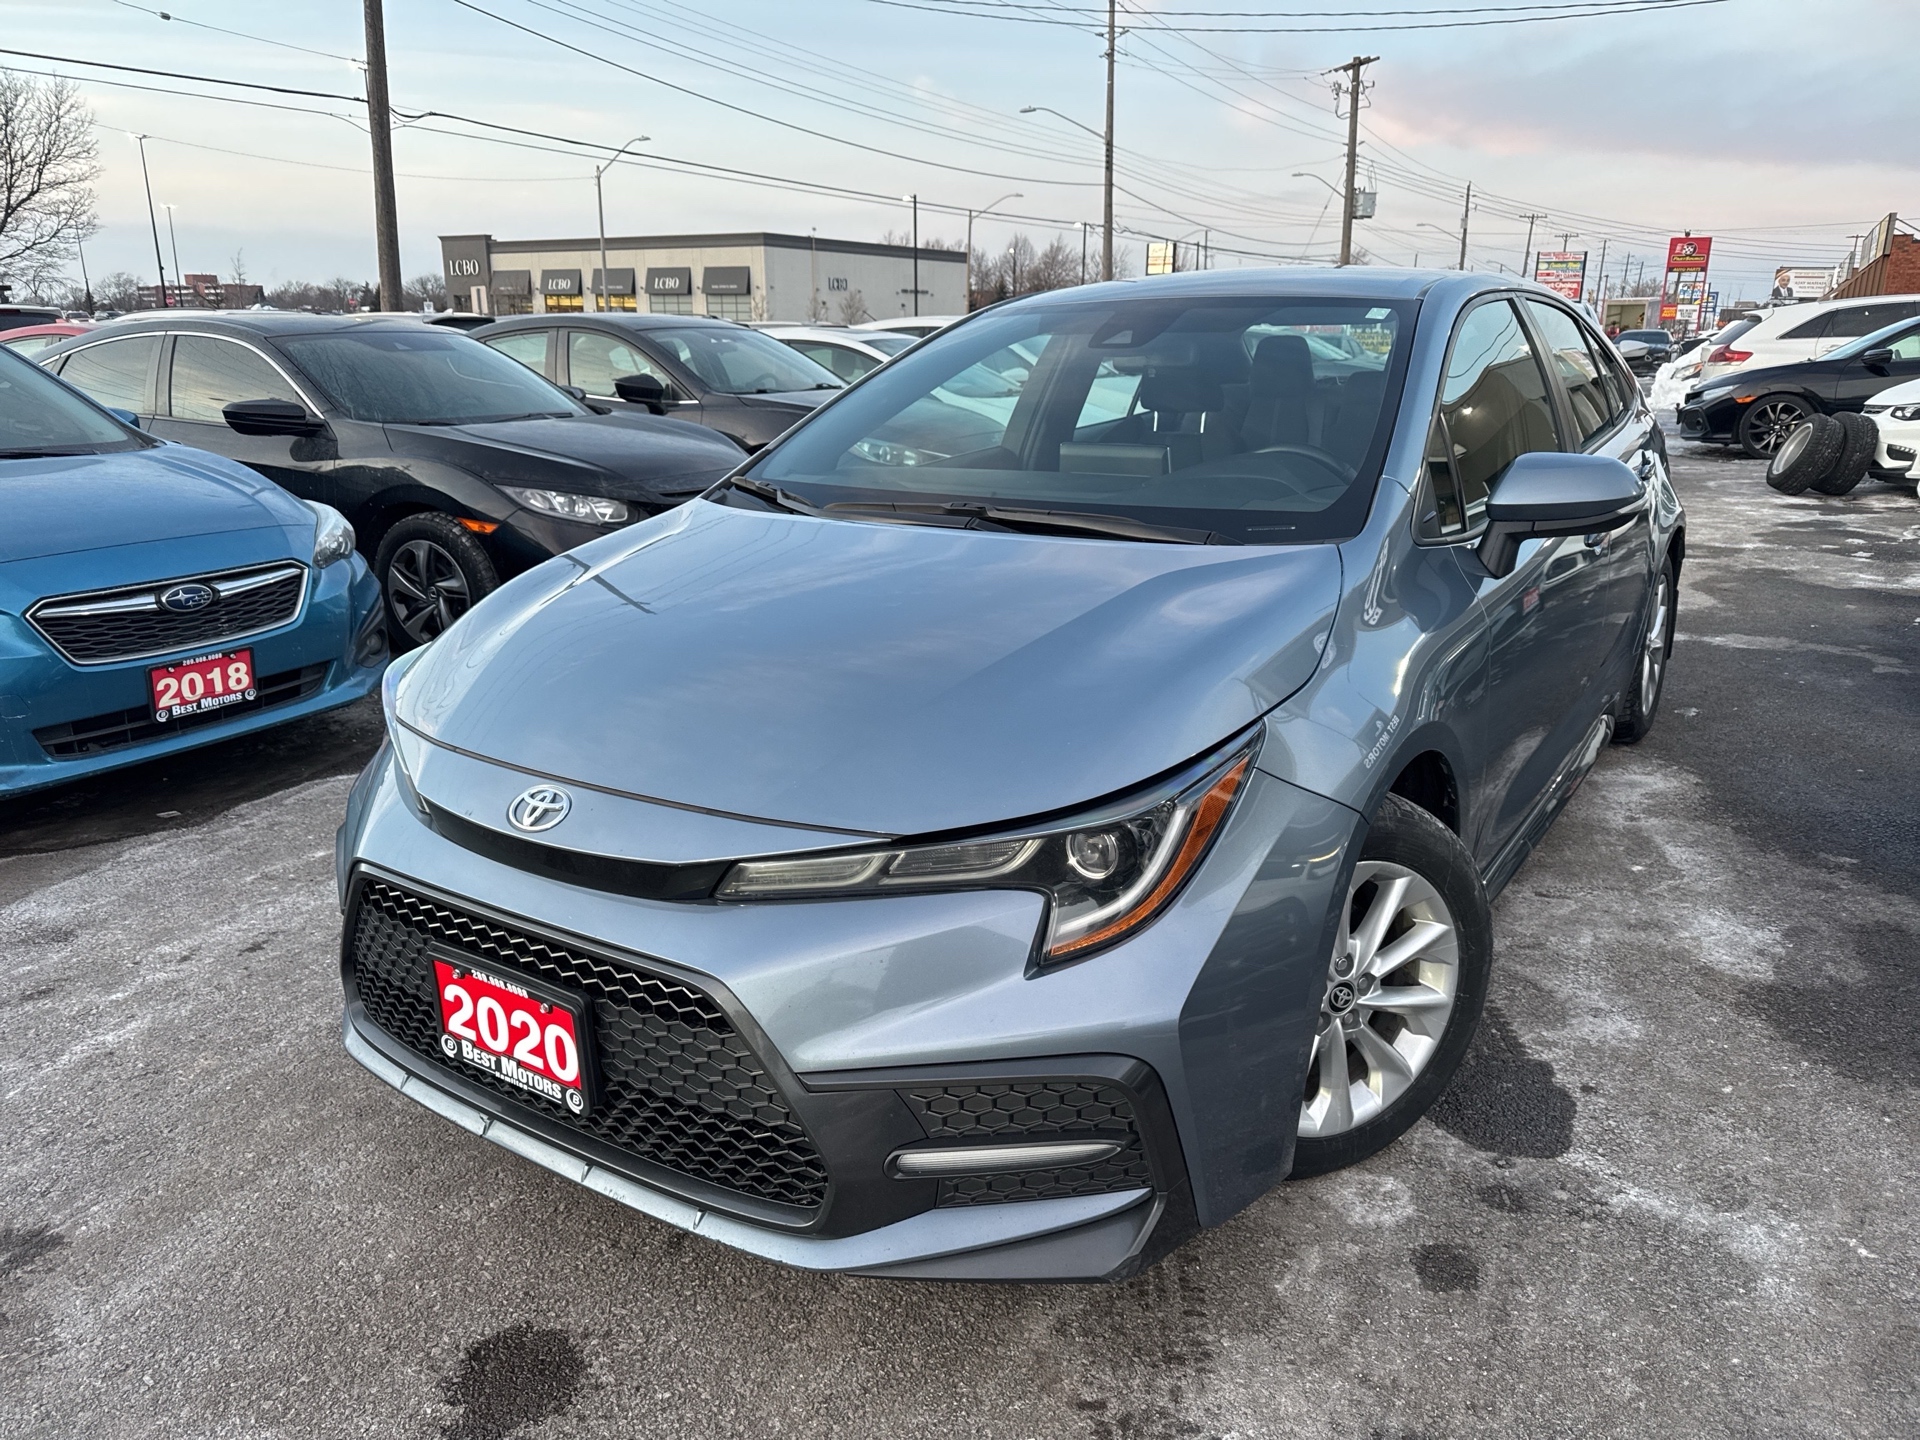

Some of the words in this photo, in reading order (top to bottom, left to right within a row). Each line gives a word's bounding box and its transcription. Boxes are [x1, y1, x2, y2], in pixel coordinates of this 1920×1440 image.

[449, 259, 479, 276] LCBO
[548, 278, 571, 290] LCBO
[654, 277, 679, 289] LCBO
[156, 661, 250, 708] 2018
[171, 702, 198, 716] BEST
[200, 692, 243, 708] MOTORS
[443, 983, 579, 1083] 2020
[461, 1039, 497, 1070] BEST
[500, 1056, 563, 1099] MOTORS
